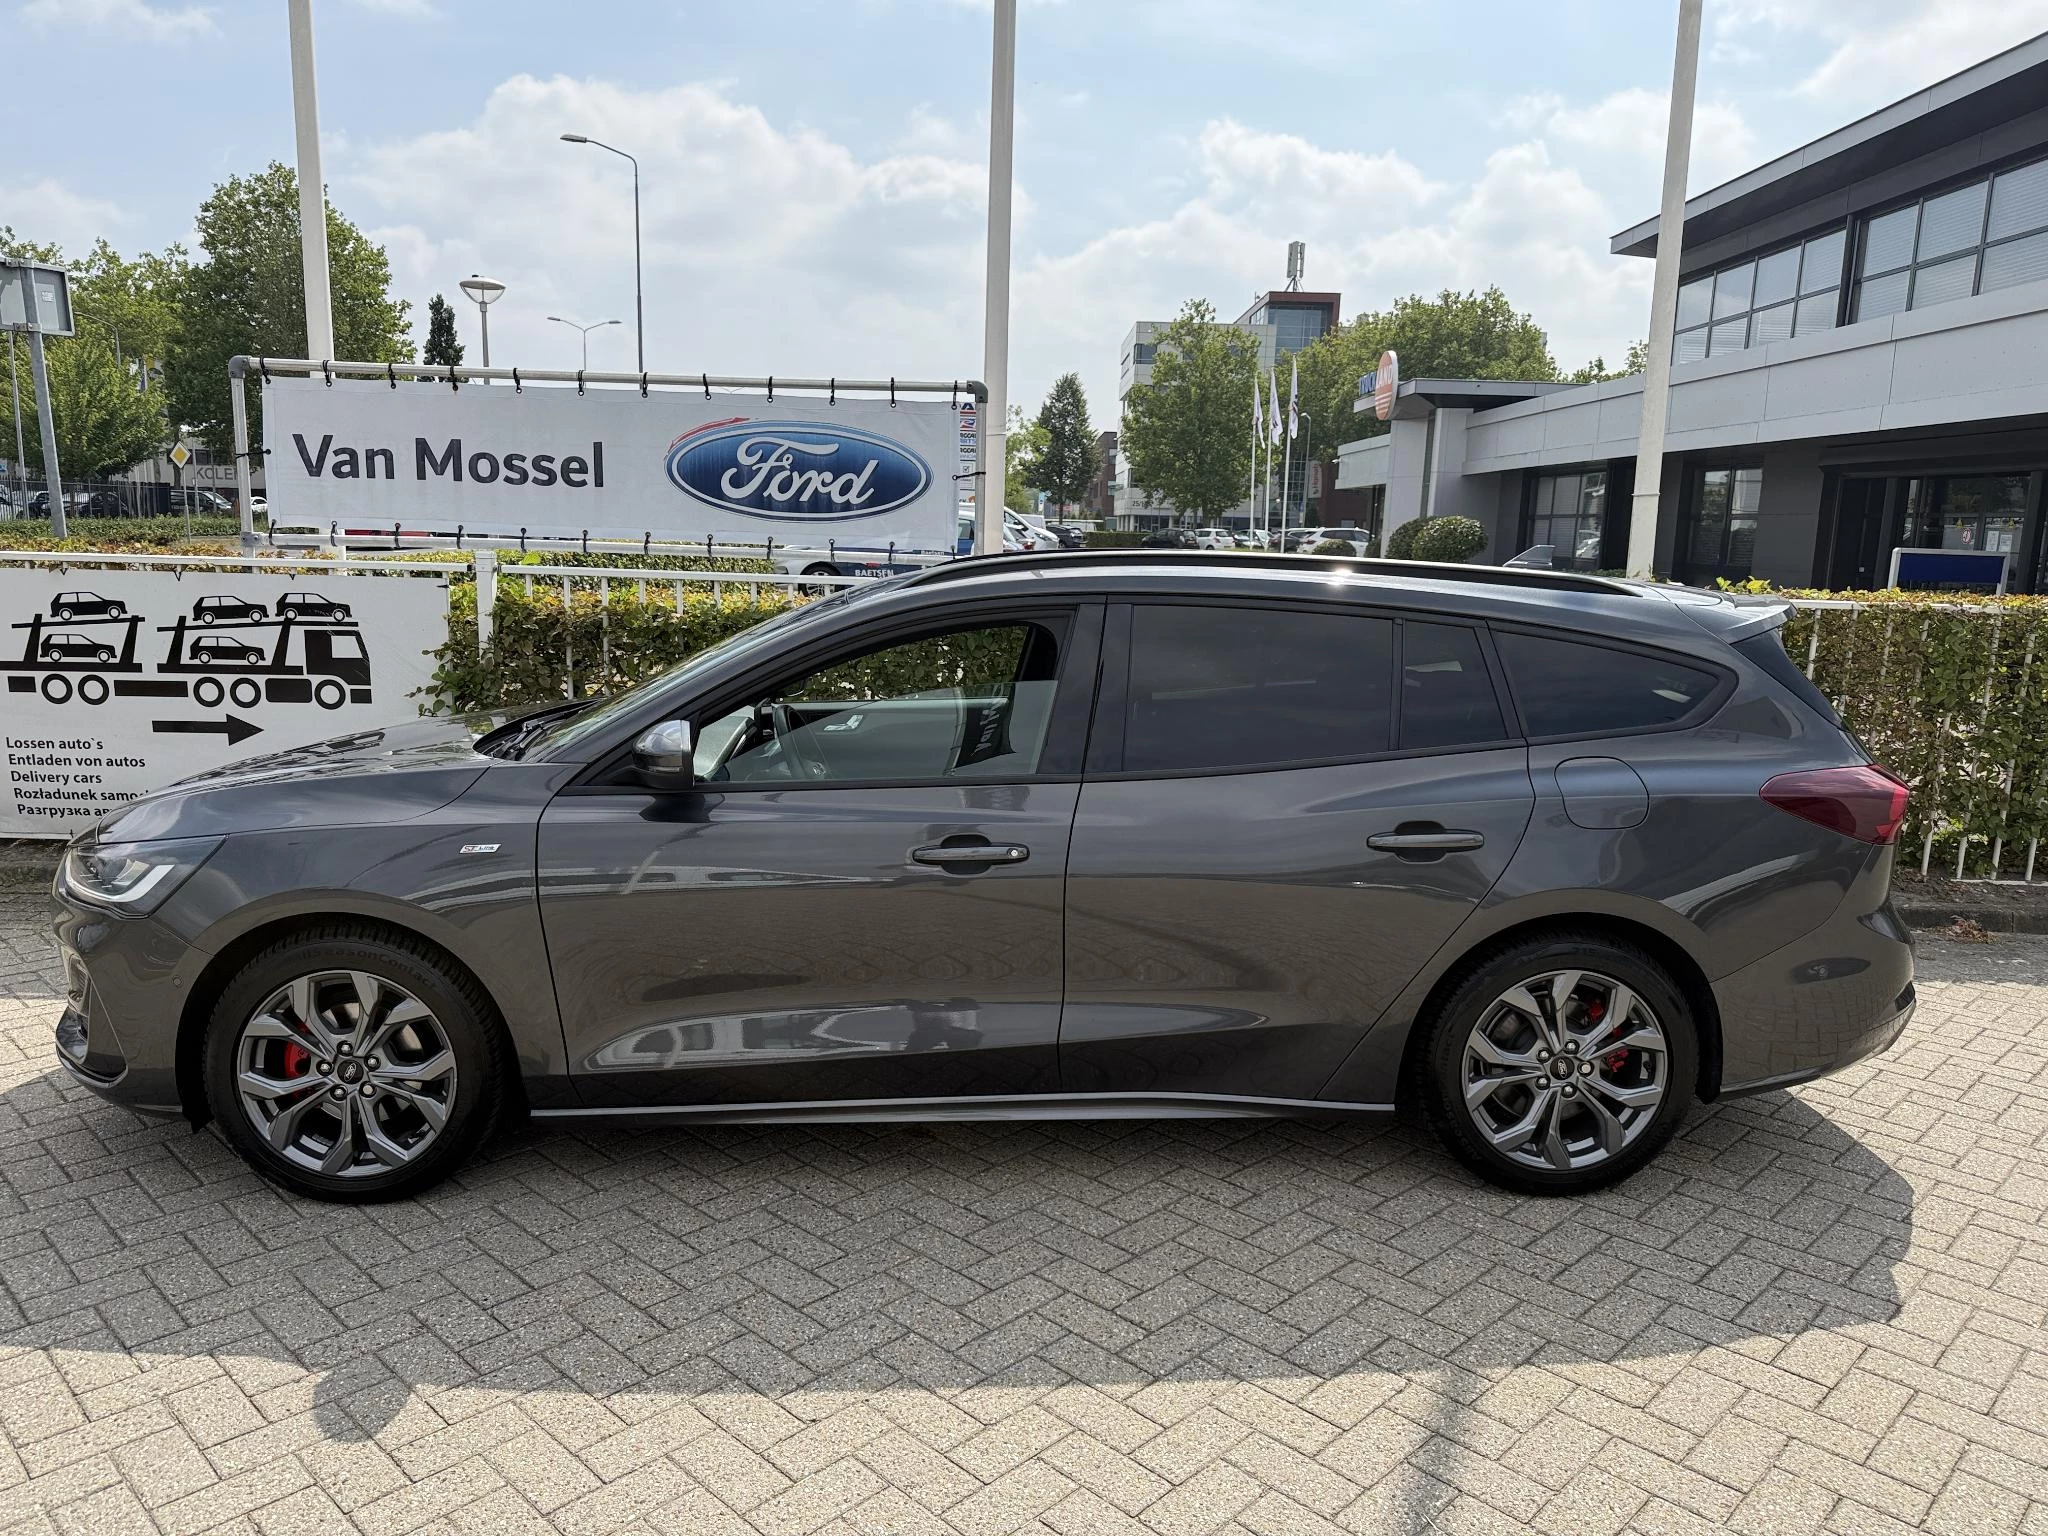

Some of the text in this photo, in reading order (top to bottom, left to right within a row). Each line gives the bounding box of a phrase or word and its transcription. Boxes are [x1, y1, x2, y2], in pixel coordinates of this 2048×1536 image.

[292, 433, 604, 488] Van Mossel
[720, 436, 879, 505] Ford
[855, 569, 894, 578] BAETSEN
[6, 737, 55, 749] Lossen
[9, 753, 146, 767] Entladen von autos
[11, 770, 103, 786] Delivery cars
[13, 787, 98, 801] Rozładunek
[17, 803, 91, 818] Разгрузка
